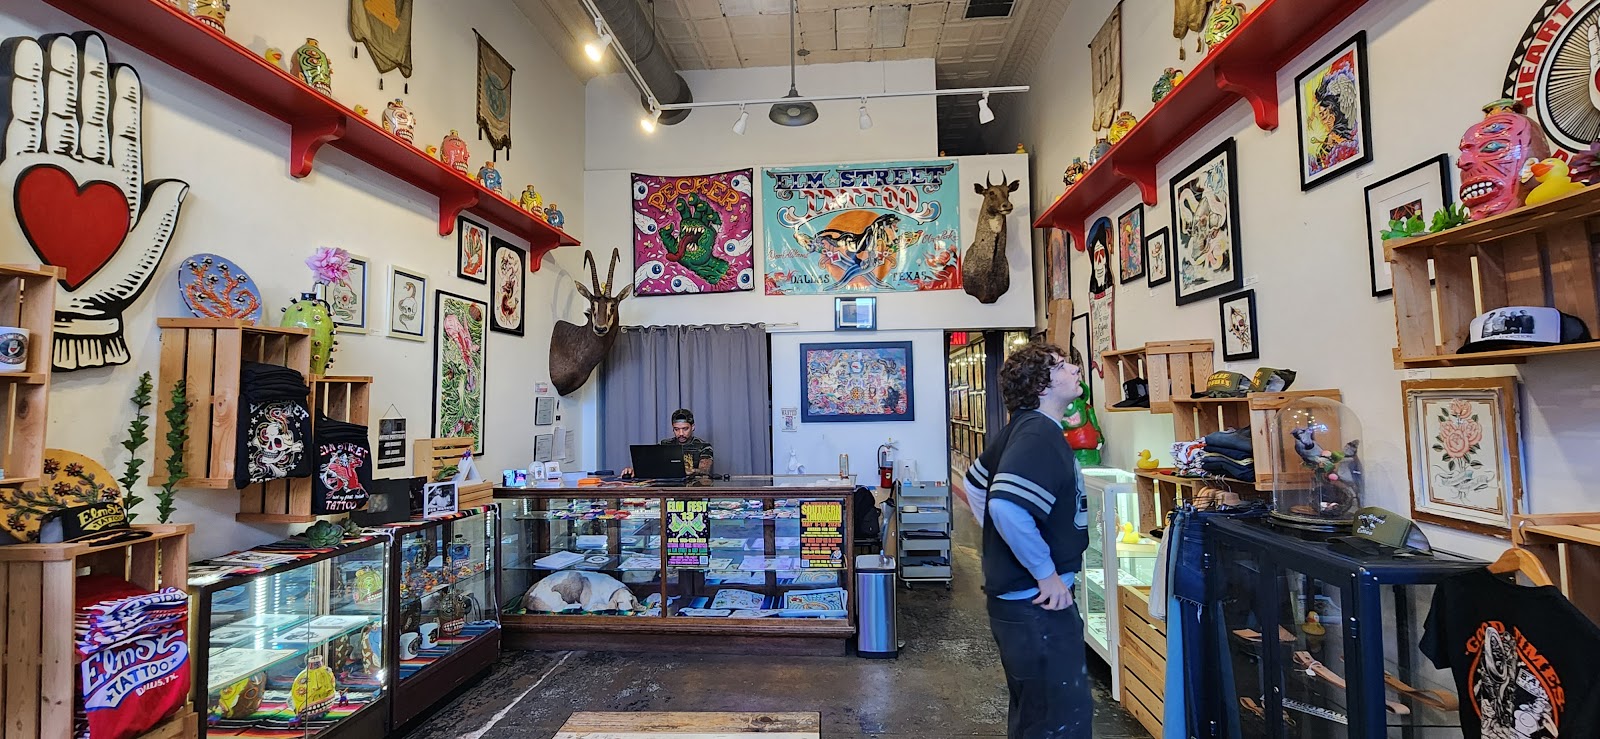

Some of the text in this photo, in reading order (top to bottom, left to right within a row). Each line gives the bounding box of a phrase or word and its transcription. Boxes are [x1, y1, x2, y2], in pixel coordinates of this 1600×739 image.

[1516, 0, 1574, 108] HEART
[774, 167, 948, 190] ELM STREET
[648, 177, 740, 212] PECKER
[799, 186, 920, 219] TATTOO
[791, 271, 927, 284] DALLAS TEXAS
[325, 500, 357, 511] TATTOO
[667, 501, 708, 512] ELM FEST
[801, 504, 842, 515] SOUTHERN
[110, 661, 169, 697] TATTOO
